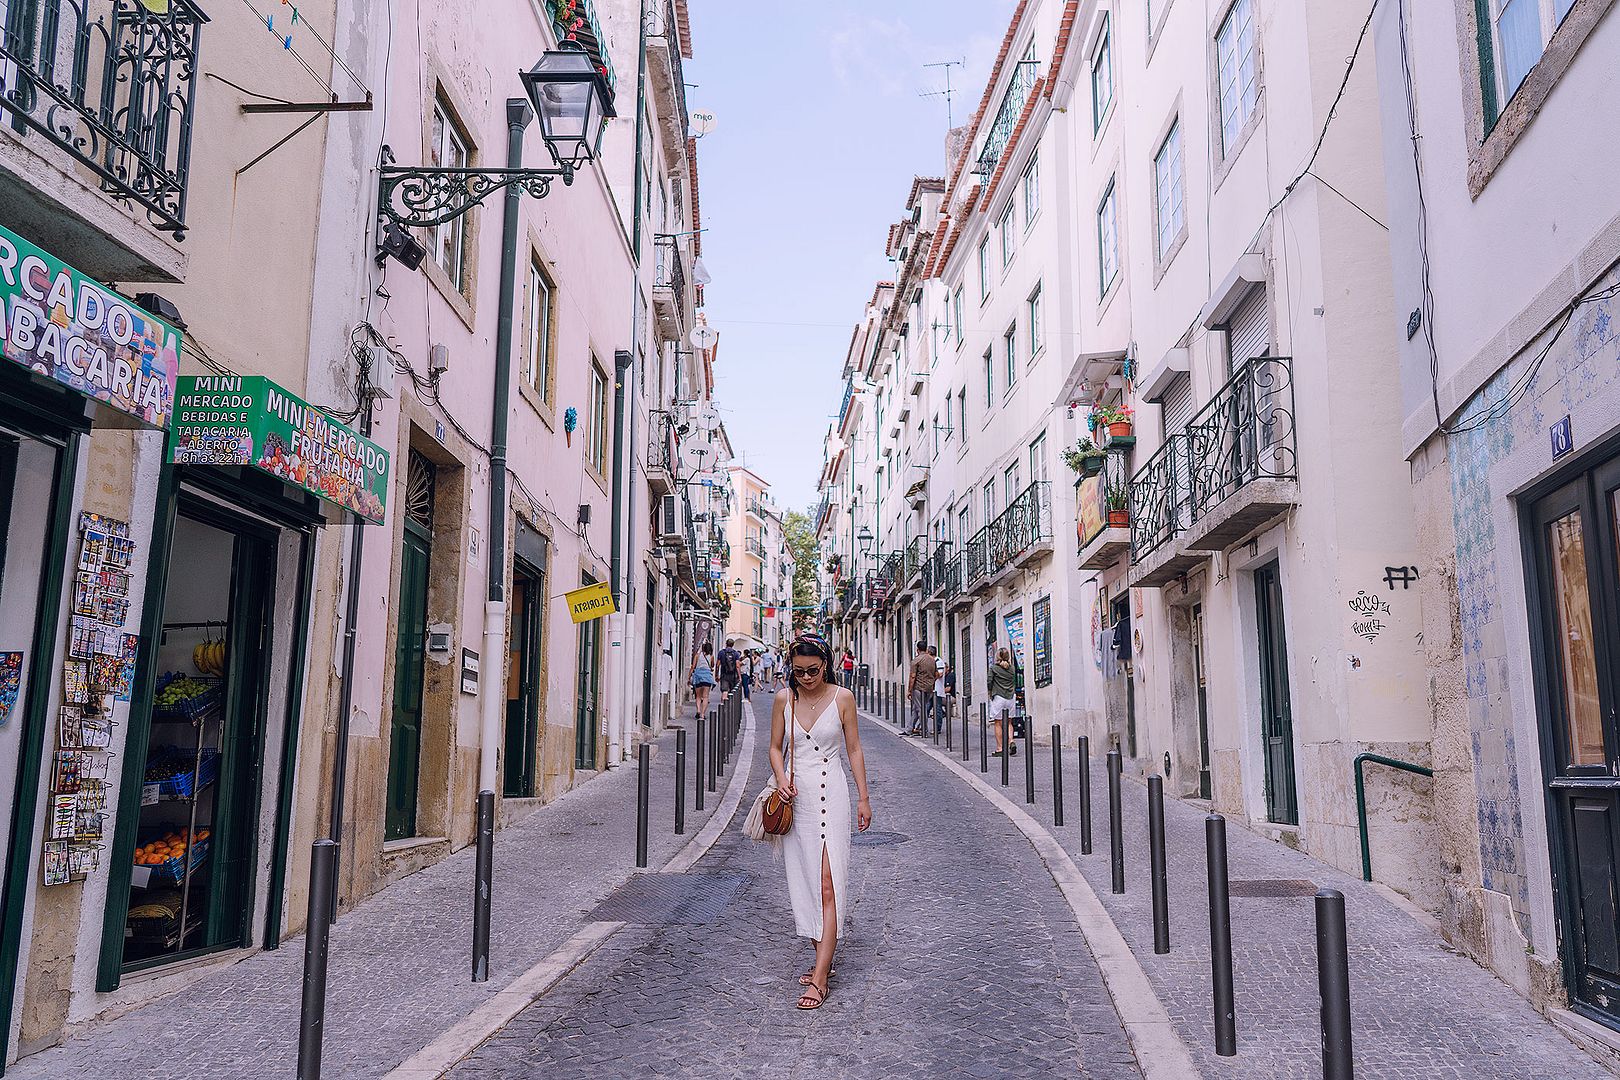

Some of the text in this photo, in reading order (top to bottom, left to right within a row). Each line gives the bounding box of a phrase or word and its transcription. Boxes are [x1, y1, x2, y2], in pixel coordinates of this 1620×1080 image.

[194, 376, 242, 391] MINI
[180, 395, 253, 408] MERCADO
[181, 412, 248, 422] BEBIDAS E
[177, 426, 250, 437] TABACARIA
[266, 388, 386, 476] MINI-MERCADO
[187, 440, 238, 450] ABERTO
[1552, 422, 1566, 455] 78
[181, 452, 197, 463] 8h
[218, 453, 242, 463] 22h
[290, 430, 365, 489] FRUTARIA
